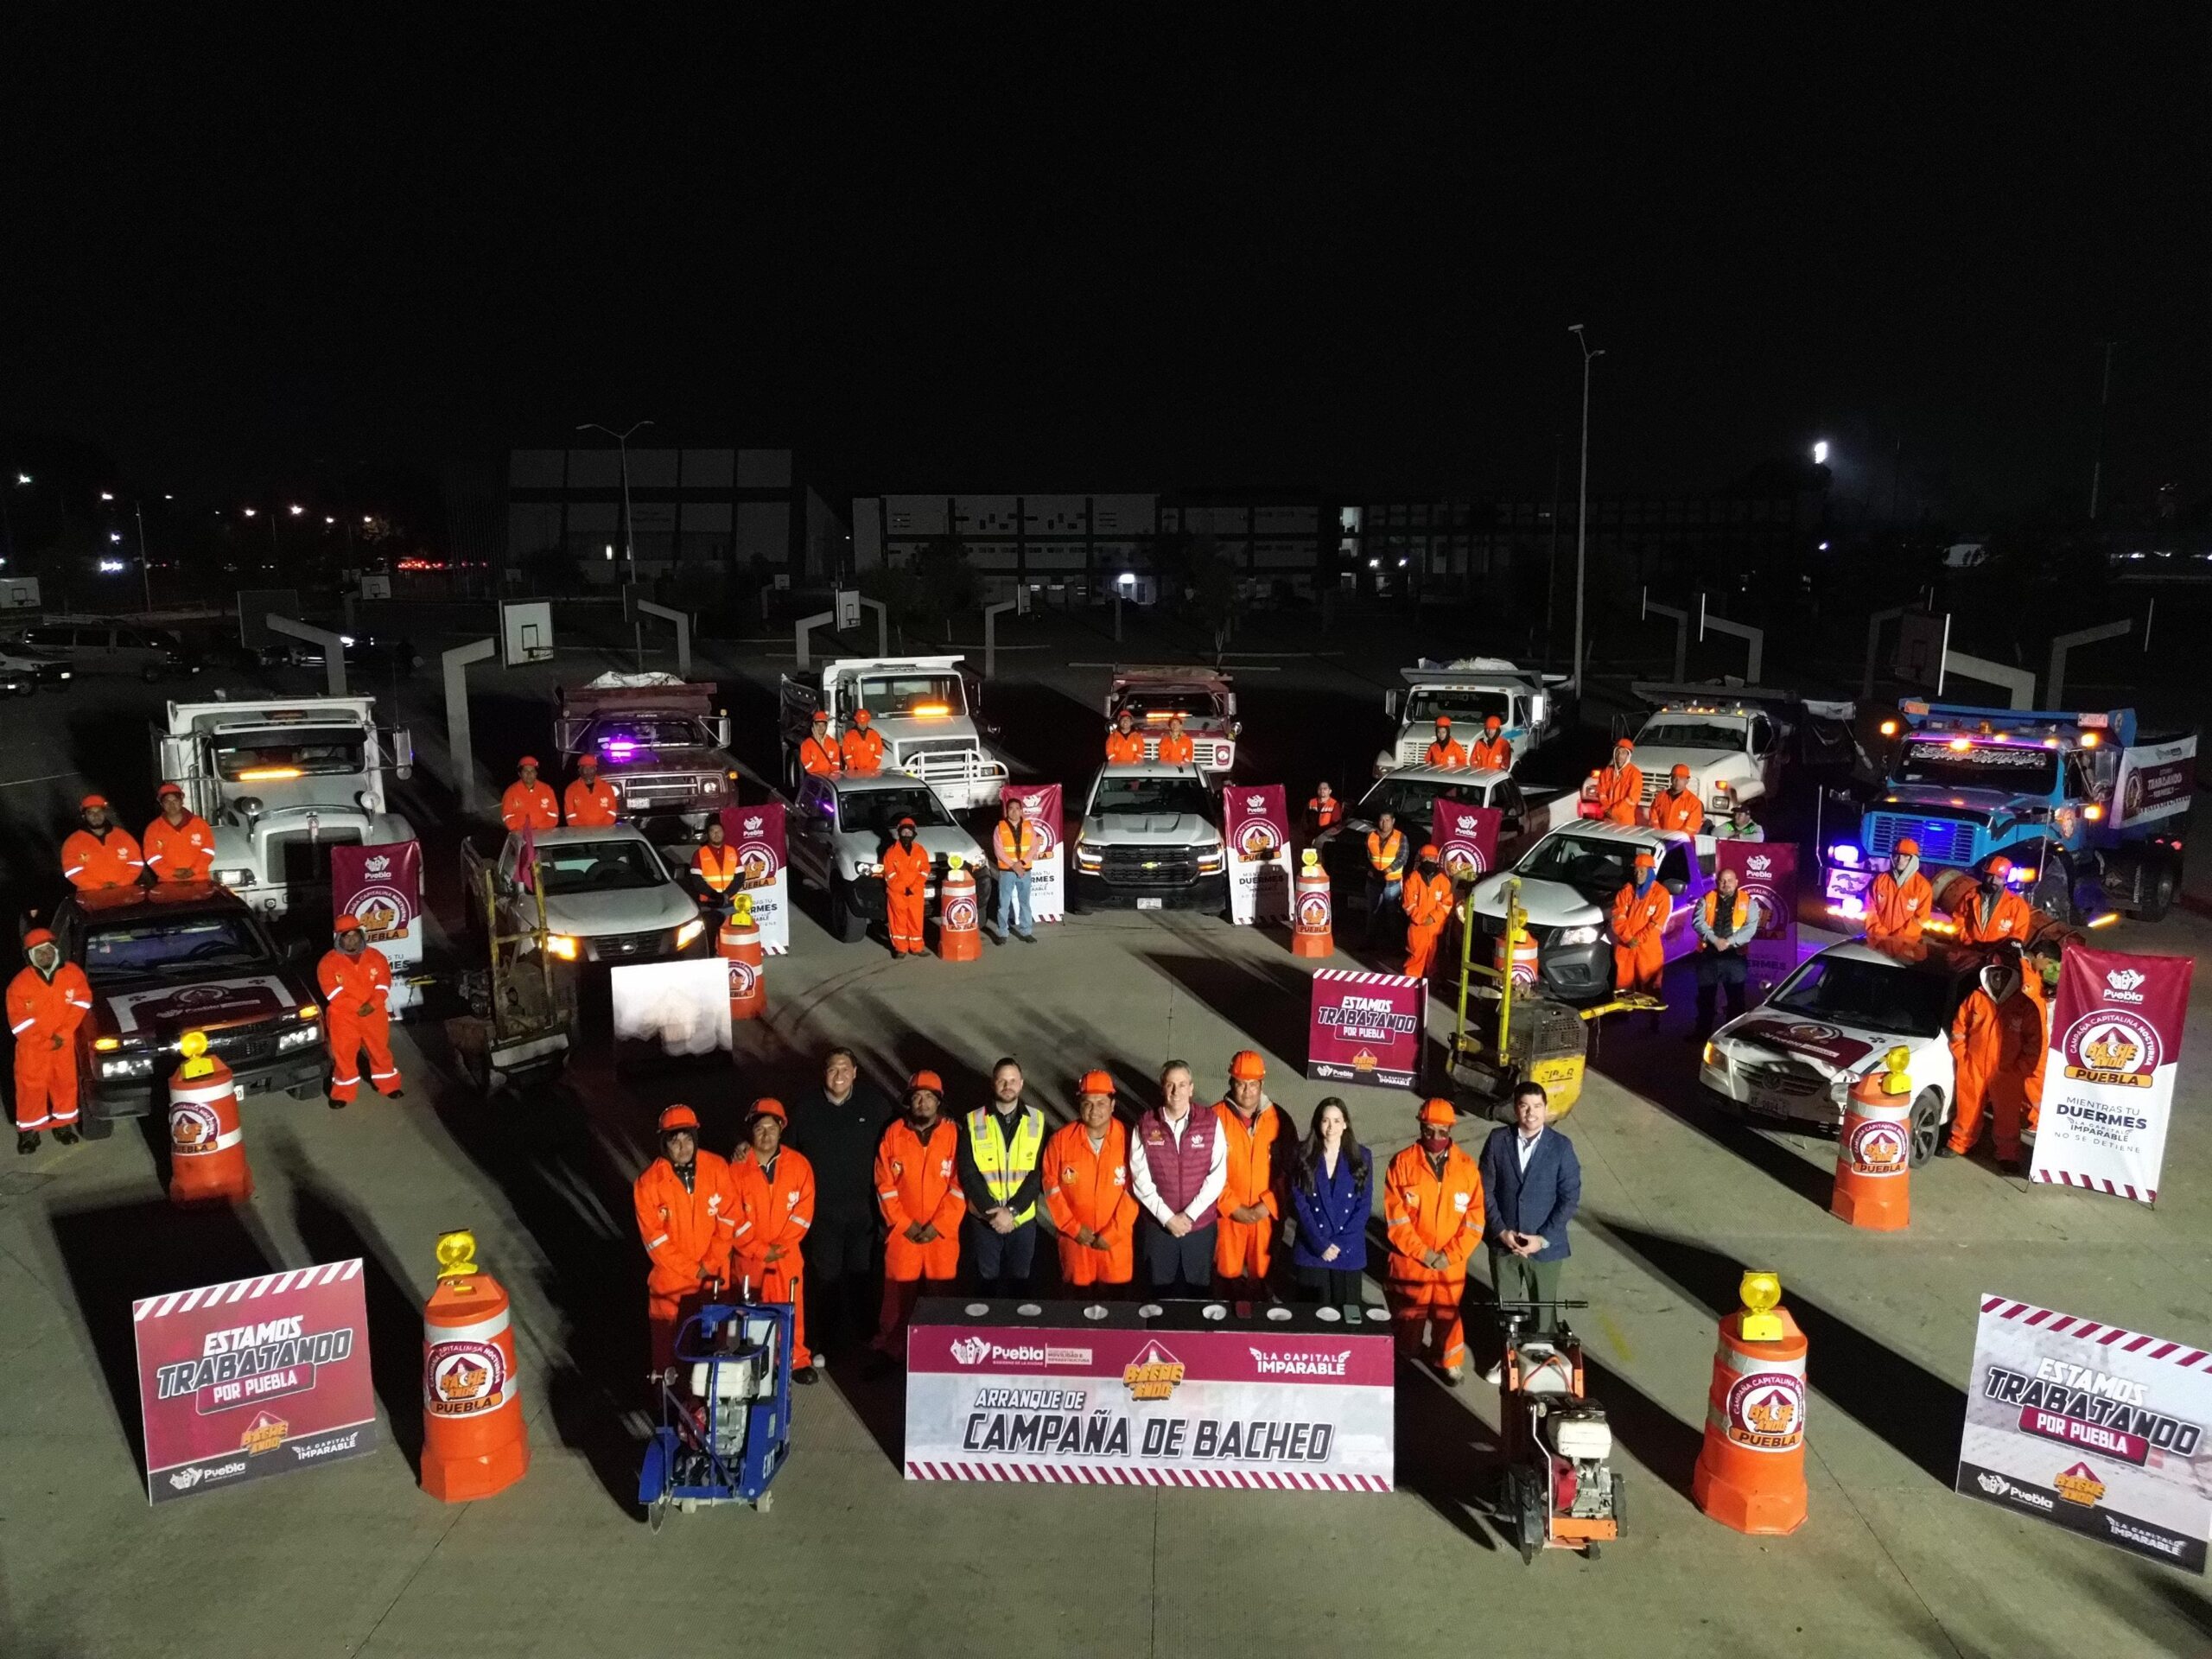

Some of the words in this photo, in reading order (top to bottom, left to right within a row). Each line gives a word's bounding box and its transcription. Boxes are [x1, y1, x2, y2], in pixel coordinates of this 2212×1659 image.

[1746, 870, 1772, 879] Puebla
[750, 904, 778, 914] RMES
[365, 931, 399, 943] UEBLA
[1746, 959, 1786, 970] ERMES
[1341, 995, 1393, 1013] ESTAMOS
[2103, 988, 2144, 1002] Puebla
[1319, 1007, 1417, 1033] TRABAJANDO
[1343, 1027, 1357, 1037] POR
[1359, 1028, 1385, 1039] PUEBLA
[2069, 1022, 2091, 1054] CAMPAÑA
[2090, 1014, 2139, 1028] CAPITALINA
[2138, 1026, 2155, 1066] NOCTURNA
[2075, 1070, 2139, 1086] PUEBLA
[2066, 1096, 2123, 1114] MIENTRAS
[2126, 1107, 2140, 1116] TU
[2056, 1103, 2147, 1130] DUERMES
[2070, 1124, 2128, 1142] IMPARABLE
[2054, 1131, 2069, 1140] NO
[2075, 1135, 2088, 1143] SE
[2093, 1139, 2140, 1154] DETIENE
[1859, 1164, 1901, 1173] PUEBLA
[203, 1315, 303, 1357] ESTAMOS
[992, 1345, 1044, 1360] Puebla
[1263, 1352, 1276, 1361] LA
[1290, 1353, 1339, 1363] CAPITAL
[157, 1328, 353, 1399] TRABAJANDO
[1257, 1361, 1345, 1376] IMPARABLE
[213, 1382, 240, 1403] POR
[245, 1370, 297, 1397] PUEBLA
[2036, 1357, 2149, 1407] ESTAMOS
[975, 1389, 1062, 1410] ARRANQUE
[1064, 1391, 1085, 1410] DE
[1733, 1384, 1752, 1414] CAMPAÑA
[1751, 1376, 1795, 1388] CAPITALINA
[436, 1397, 492, 1413] PUEBLA
[1986, 1366, 2202, 1457] TRABAJANDO
[315, 1435, 352, 1449] CAPITAL
[963, 1409, 1130, 1457] CAMPAÑA
[1141, 1417, 1189, 1459] DE
[1192, 1419, 1334, 1463] BACHEO
[1739, 1433, 1796, 1447] PUEBLA
[2037, 1413, 2067, 1436] POR
[2070, 1421, 2128, 1454] PUEBLA
[298, 1440, 356, 1460] IMPARABLE
[204, 1461, 246, 1479] Puebla
[2010, 1487, 2053, 1509] Puebla
[2111, 1526, 2182, 1556] IMPARABLE
[2131, 1527, 2174, 1545] CAPITAL
